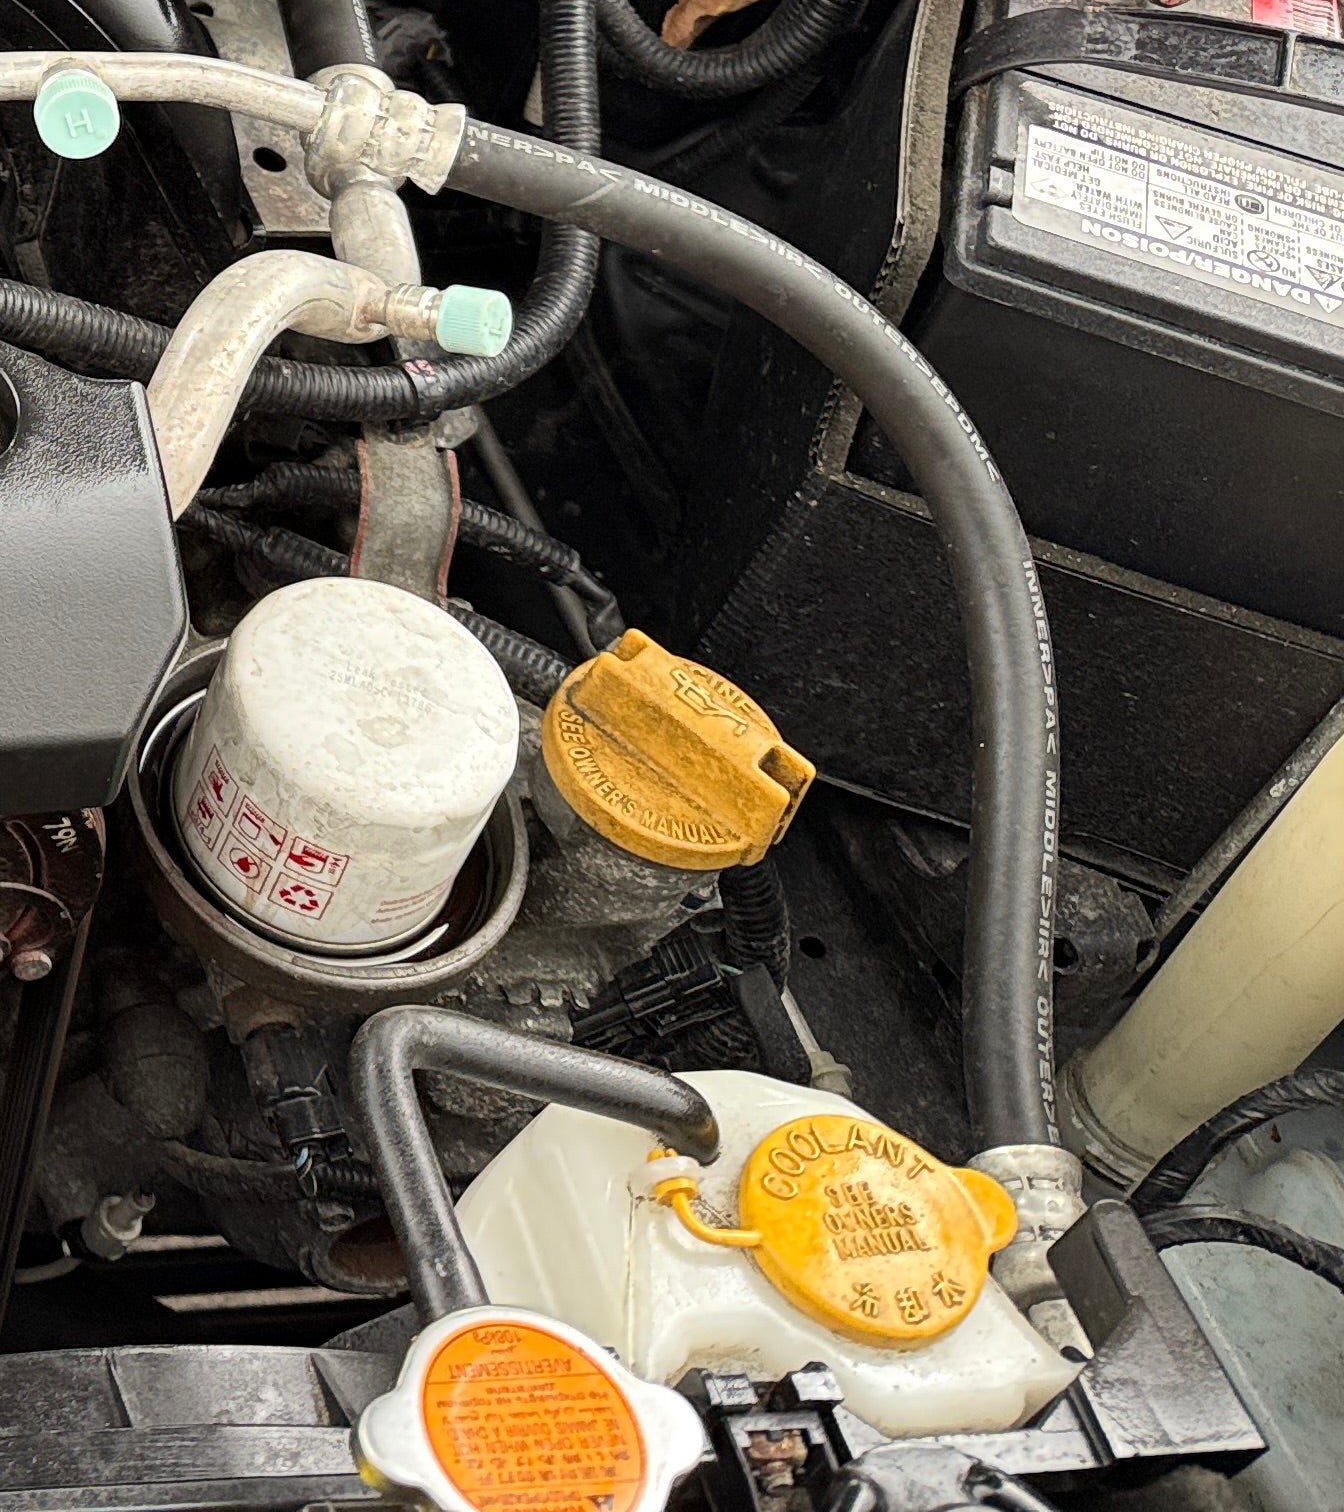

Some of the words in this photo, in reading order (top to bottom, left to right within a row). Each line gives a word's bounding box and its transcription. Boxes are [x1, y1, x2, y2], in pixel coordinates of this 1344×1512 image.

[65, 110, 94, 139] H
[1051, 119, 1078, 134] NOT
[1078, 127, 1099, 141] DO
[1079, 151, 1106, 166] OPEN
[1108, 153, 1128, 165] NOT
[1148, 150, 1168, 163] OR
[1029, 156, 1077, 179] MEDICAL
[1064, 159, 1090, 173] HELP
[1108, 161, 1128, 173] NOT
[1130, 160, 1145, 170] DO
[1130, 168, 1145, 178] DO
[1169, 156, 1239, 185] EXPLOSION
[1080, 173, 1101, 186] GET
[1155, 168, 1230, 198] INSTRUCTIONS
[1180, 184, 1201, 196] ALL
[1275, 190, 1294, 202] OF
[1070, 189, 1142, 219] IMMEDIATELY
[1113, 194, 1143, 210] WITH
[1203, 191, 1230, 206] READ
[1294, 196, 1325, 212] RISK
[1078, 201, 1105, 216] EYES
[1273, 205, 1325, 228] CHILDREN
[1108, 211, 1142, 228] FLUSH
[1224, 212, 1237, 222] OR
[1291, 220, 1311, 231] THE
[1313, 226, 1327, 236] OF
[1327, 222, 1342, 233] OF
[1184, 235, 1239, 259] SULFURIC
[1211, 233, 1238, 248] ACID
[1078, 217, 1313, 304] DANGER/POISON
[1280, 266, 1297, 278] NO
[833, 281, 1000, 483] OUTER>EPDM<
[1022, 559, 1058, 756] INNER>PA<
[560, 709, 584, 744] SEE
[569, 747, 638, 816] OWNER'S
[641, 807, 726, 846] MANUAL
[1037, 770, 1058, 983] MIDDLE>IIR<
[762, 1122, 935, 1201] COOLANT
[824, 1181, 875, 1218] SEE
[831, 1229, 931, 1261] MANUAL
[472, 1327, 521, 1346] 108kPa
[448, 1355, 571, 1381] AVERTISSEMENT
[534, 1436, 573, 1452] OPEN
